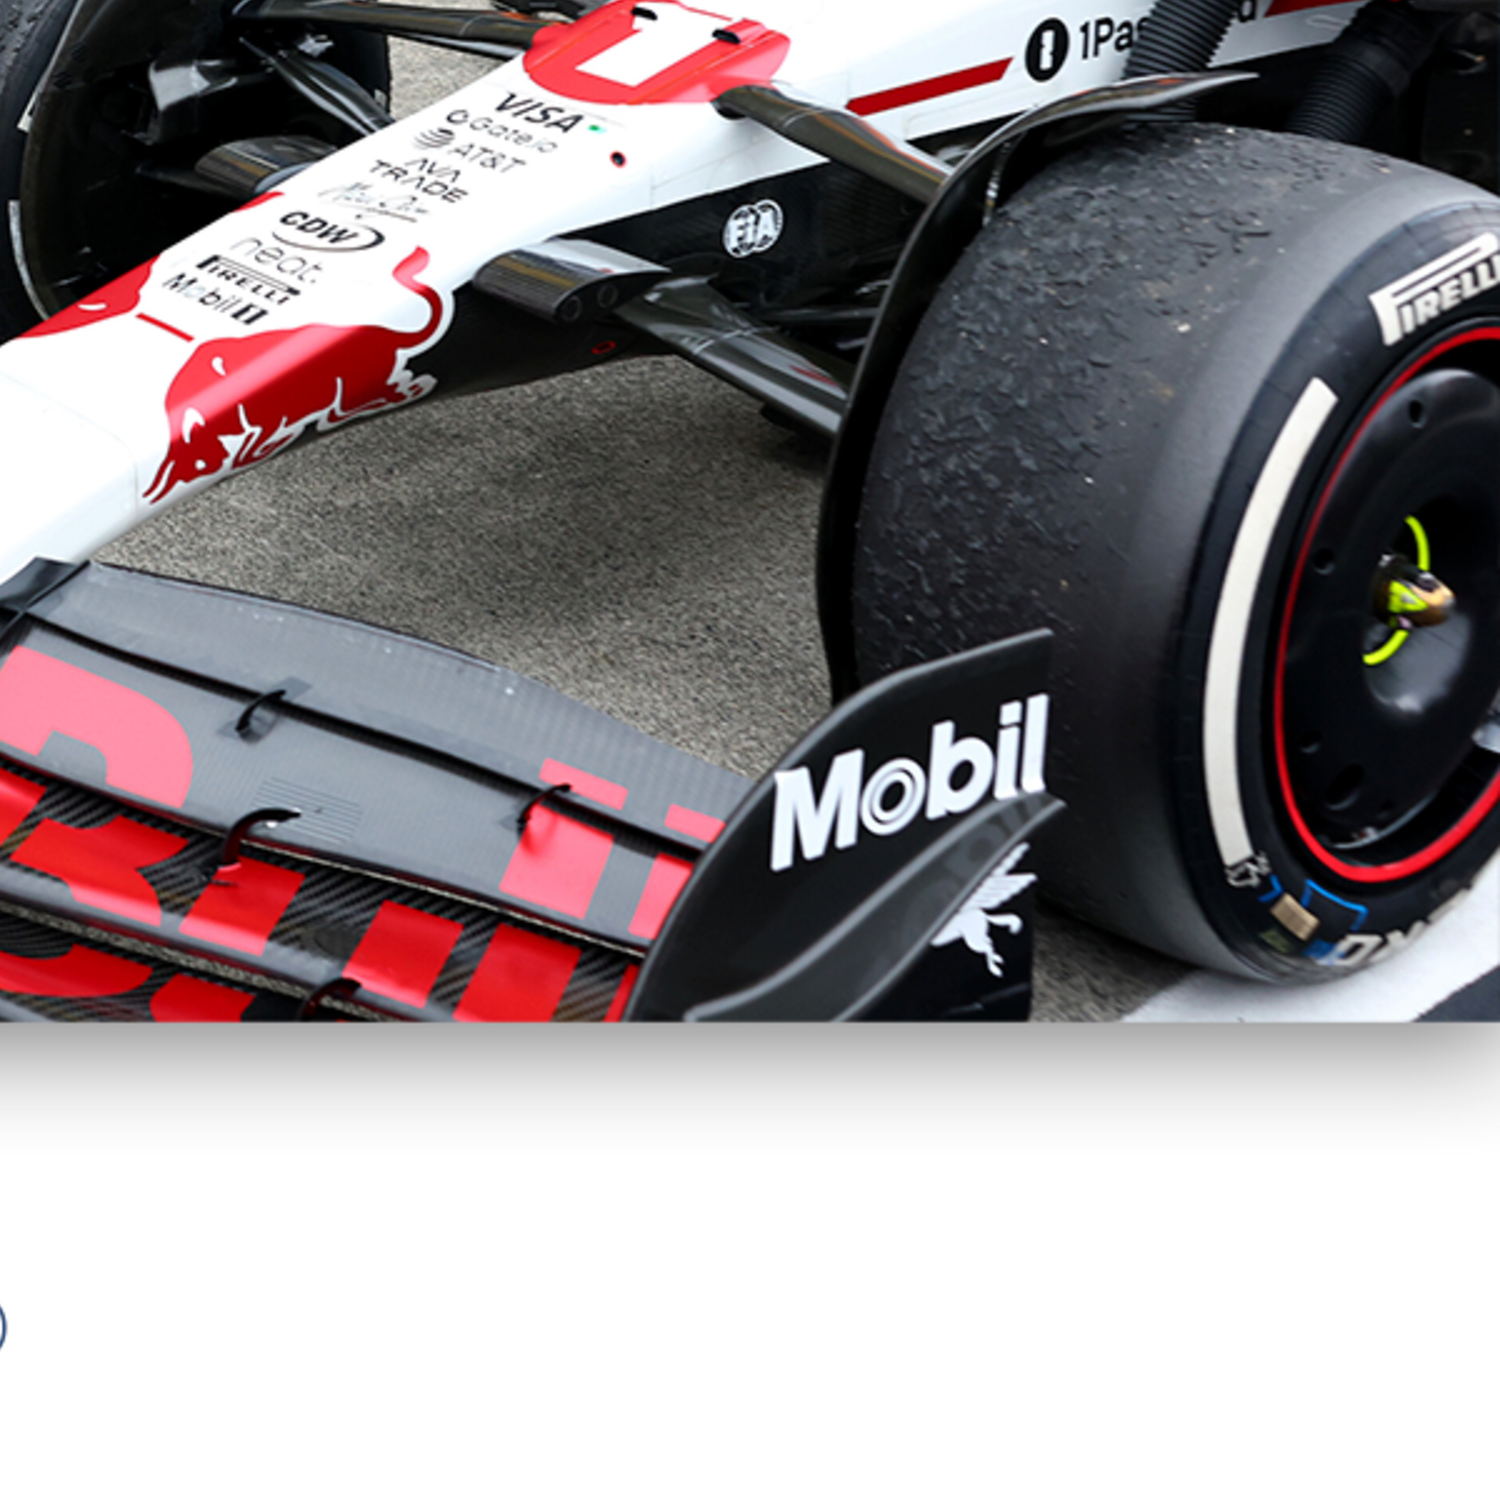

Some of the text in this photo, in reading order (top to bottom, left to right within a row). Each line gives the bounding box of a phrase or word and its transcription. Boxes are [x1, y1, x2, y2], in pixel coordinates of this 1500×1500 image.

[494, 92, 584, 133] VISA
[452, 143, 527, 174] AT&T
[369, 159, 469, 203] TRADE
[280, 211, 359, 244] CDW
[162, 272, 241, 313] Mobil
[196, 254, 301, 305] PIRELLI
[771, 694, 1049, 871] Mobil
